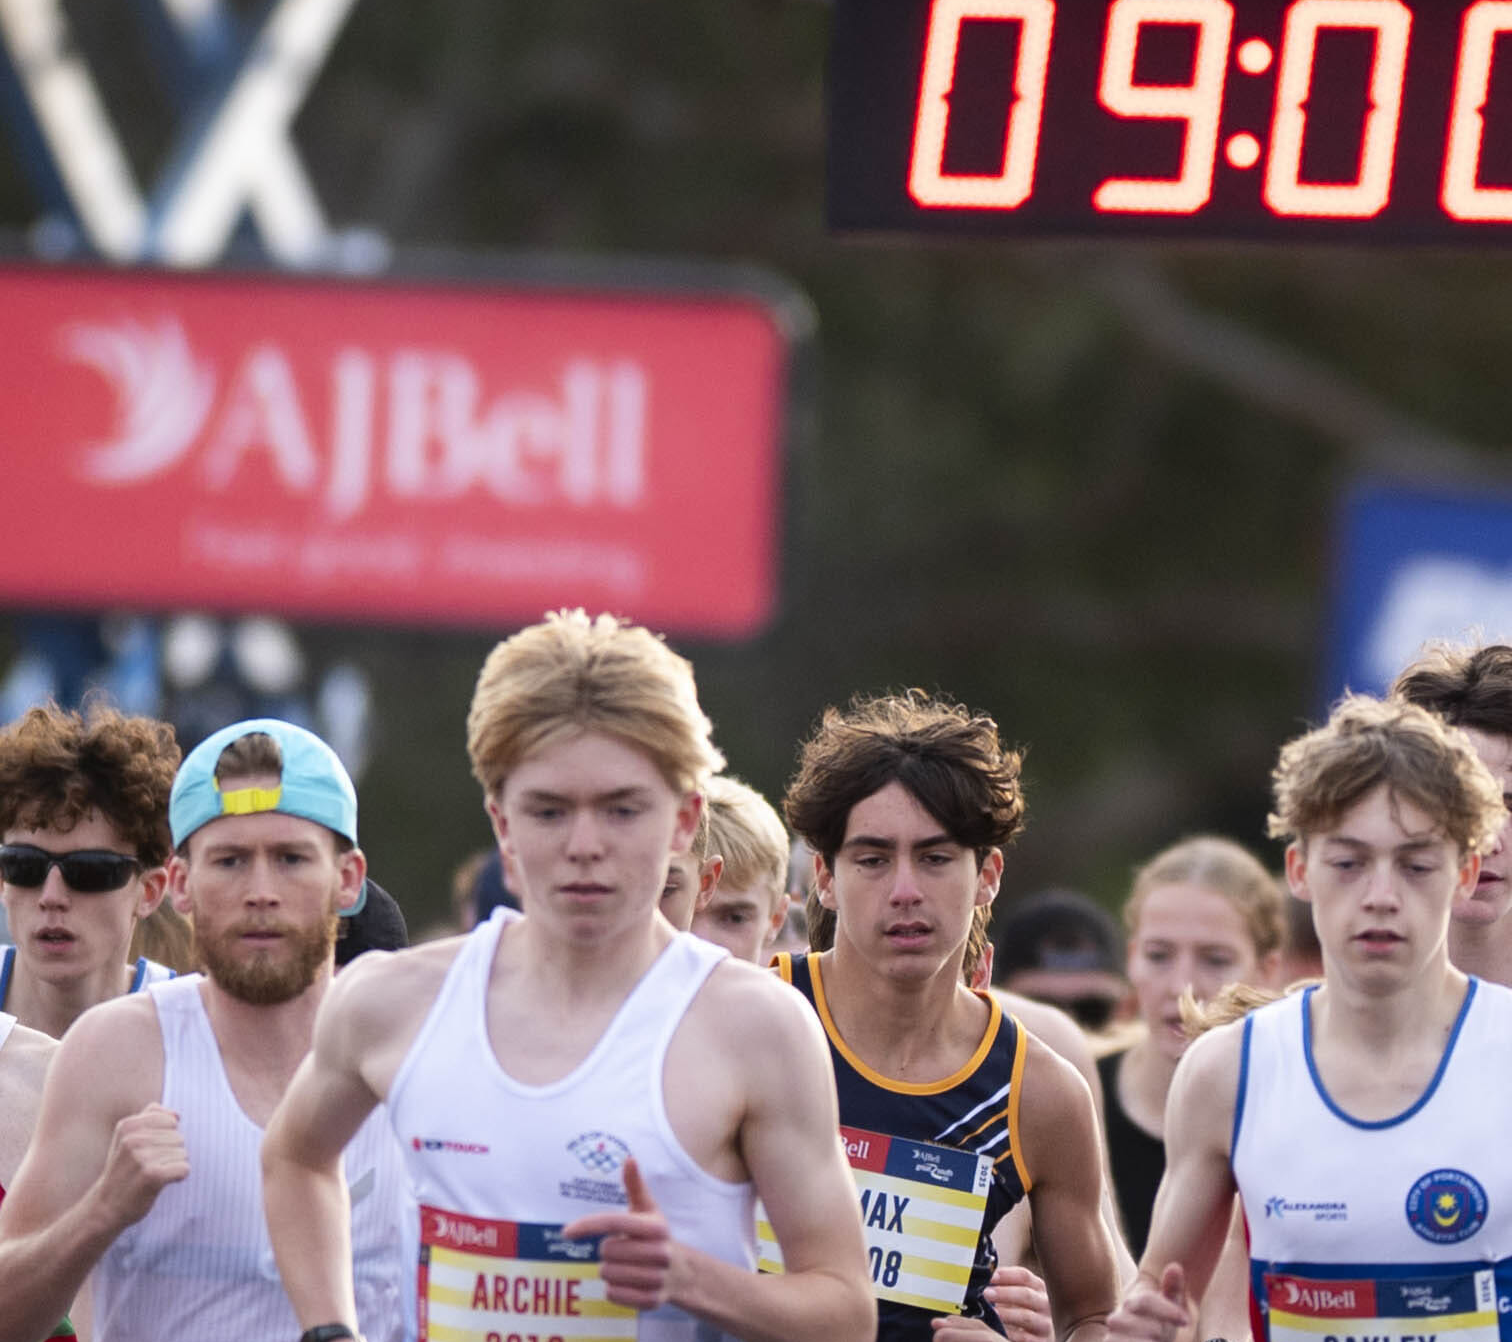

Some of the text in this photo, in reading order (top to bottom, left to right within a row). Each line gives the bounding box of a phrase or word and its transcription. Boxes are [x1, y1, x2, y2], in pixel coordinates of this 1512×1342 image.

[200, 344, 648, 523] AJBell
[472, 1272, 582, 1317] ARCHIE
[1295, 1289, 1356, 1311] AJBell
